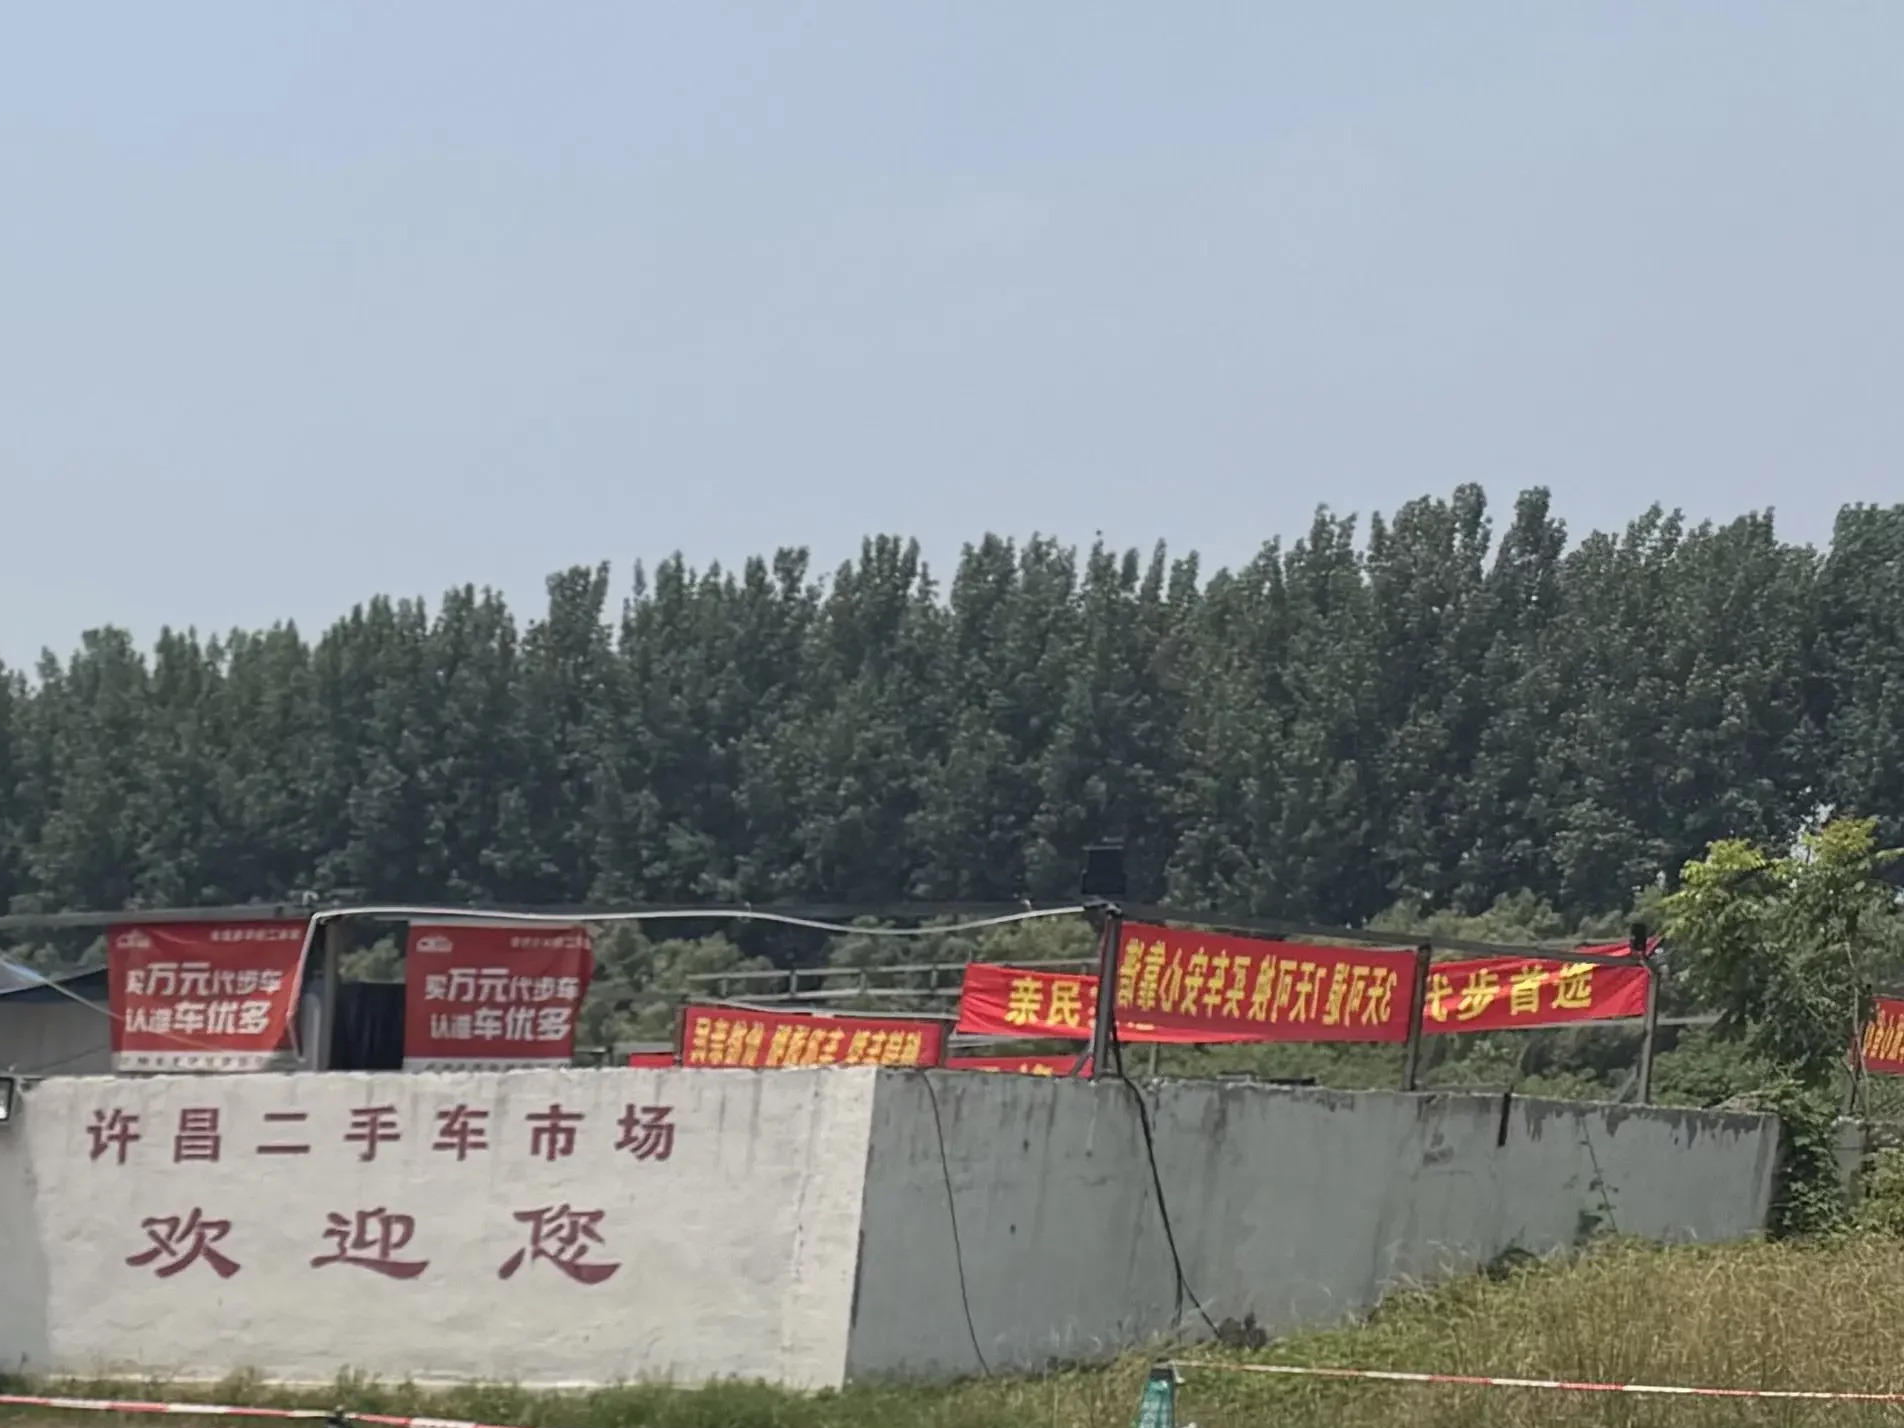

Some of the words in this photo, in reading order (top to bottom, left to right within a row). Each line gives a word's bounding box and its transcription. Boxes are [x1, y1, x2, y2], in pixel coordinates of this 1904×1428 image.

[125, 961, 284, 996] 买万元代步车
[424, 968, 580, 1001] 买万元代步车
[1004, 976, 1098, 1028] 亲民
[86, 1104, 676, 1166] 许昌二手车市场
[125, 1204, 621, 1286] 欢迎您
